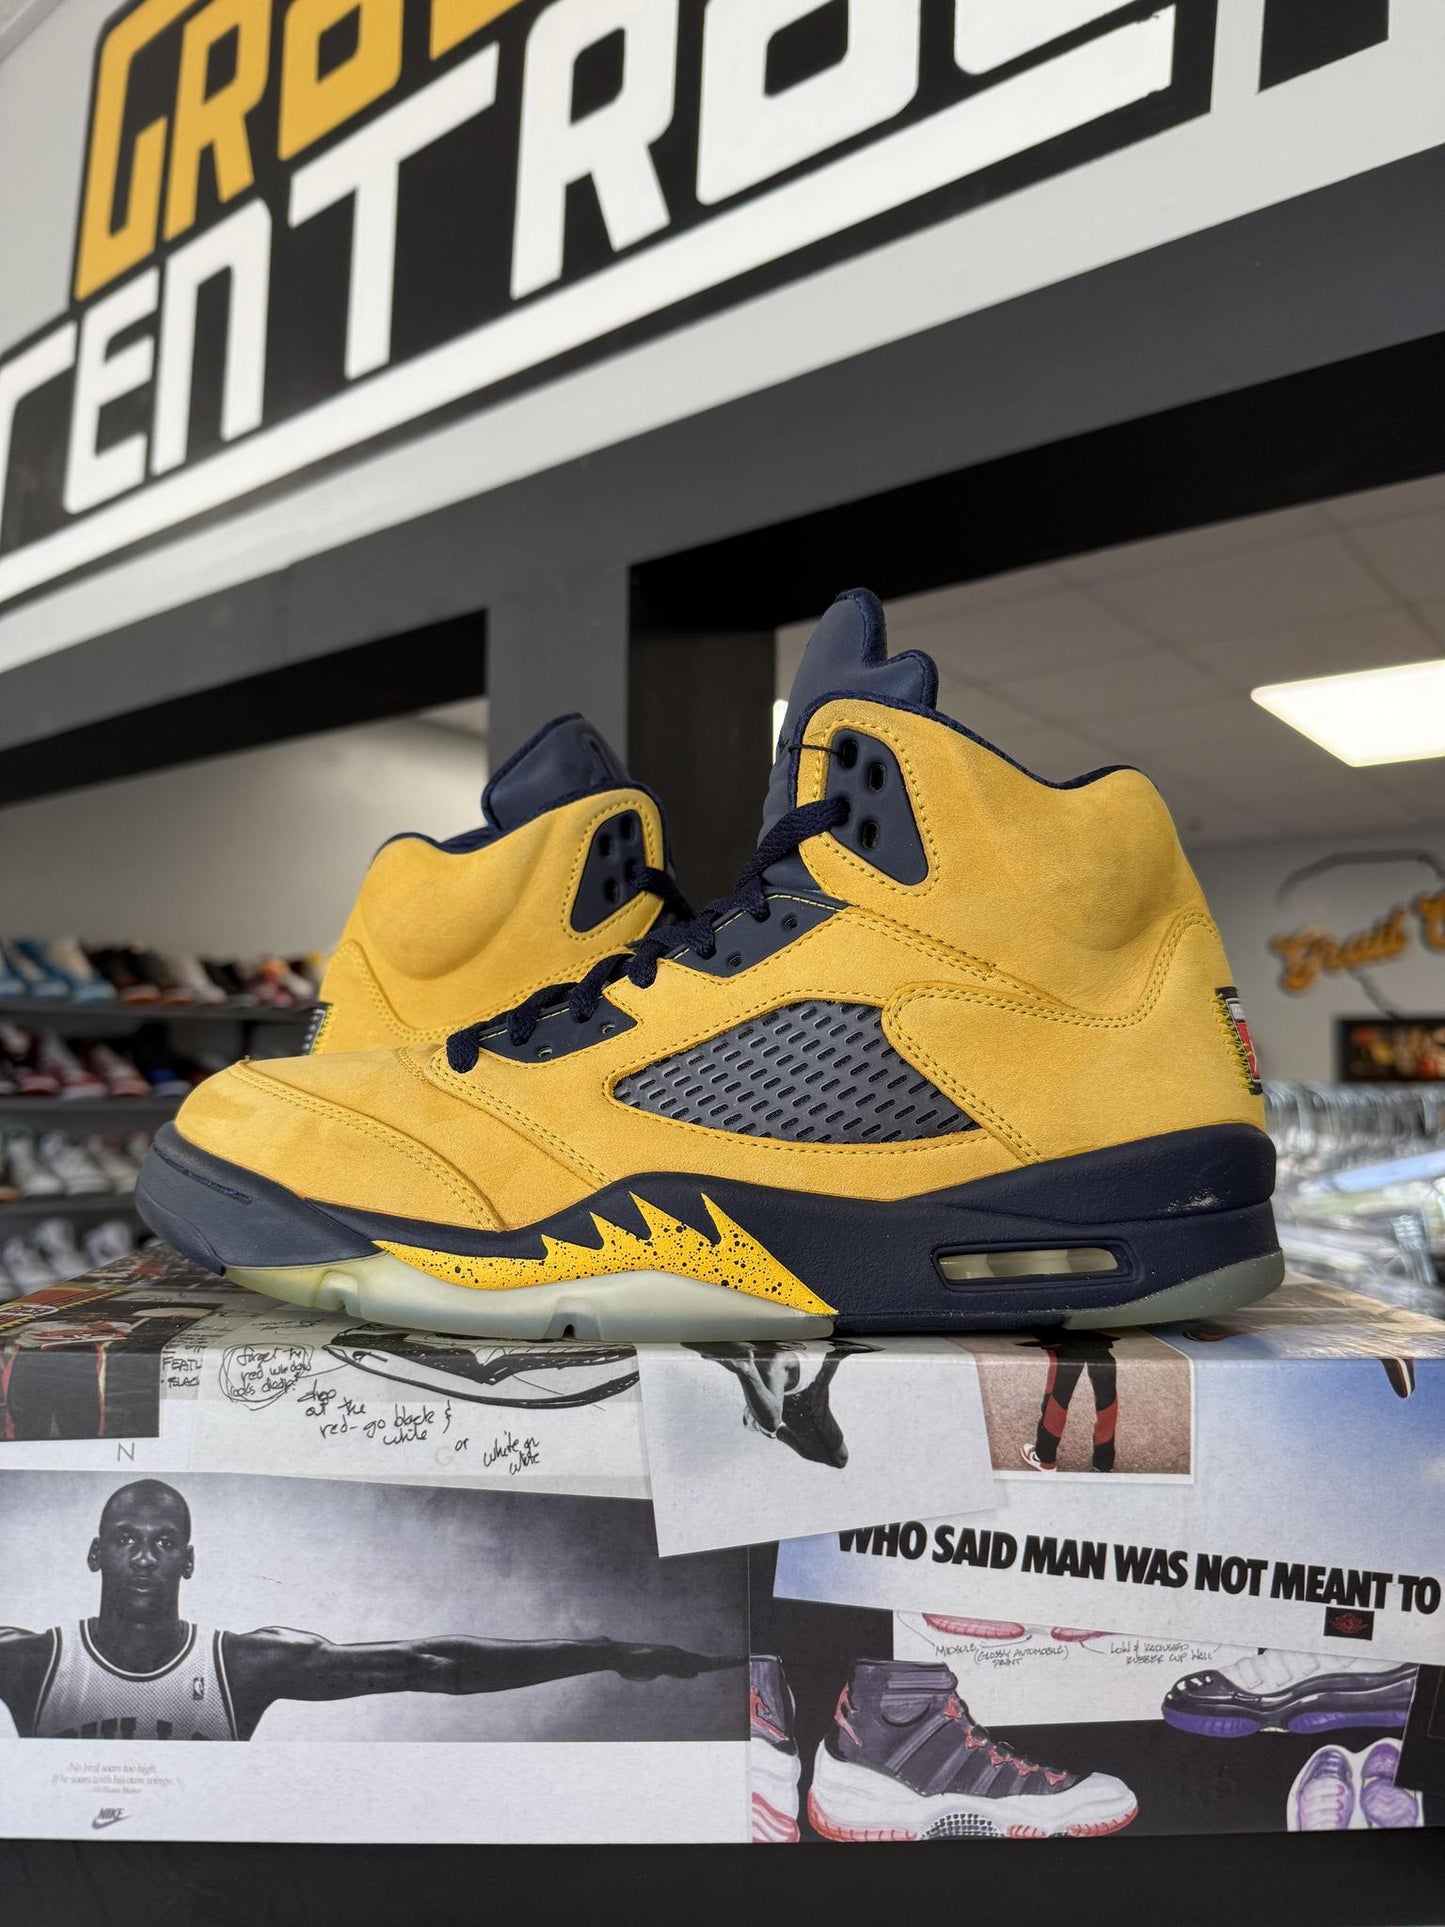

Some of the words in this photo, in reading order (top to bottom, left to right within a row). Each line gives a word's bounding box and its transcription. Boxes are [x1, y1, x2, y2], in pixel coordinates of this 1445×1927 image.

[241, 1369, 264, 1388] red
[338, 1397, 367, 1416] the
[394, 1404, 435, 1428] black
[383, 1427, 428, 1446] white
[117, 1441, 135, 1462] N
[455, 1438, 469, 1451] or
[483, 1430, 519, 1467] white
[509, 1450, 540, 1476] white
[839, 1520, 927, 1560] WHO
[932, 1524, 1018, 1569] SAID
[1021, 1535, 1107, 1580] MAN
[1113, 1543, 1188, 1588] WAS
[1194, 1553, 1268, 1597] NOT
[1270, 1561, 1393, 1610] MEANT
[1397, 1574, 1441, 1615] TO
[97, 1807, 125, 1820] NIKE
